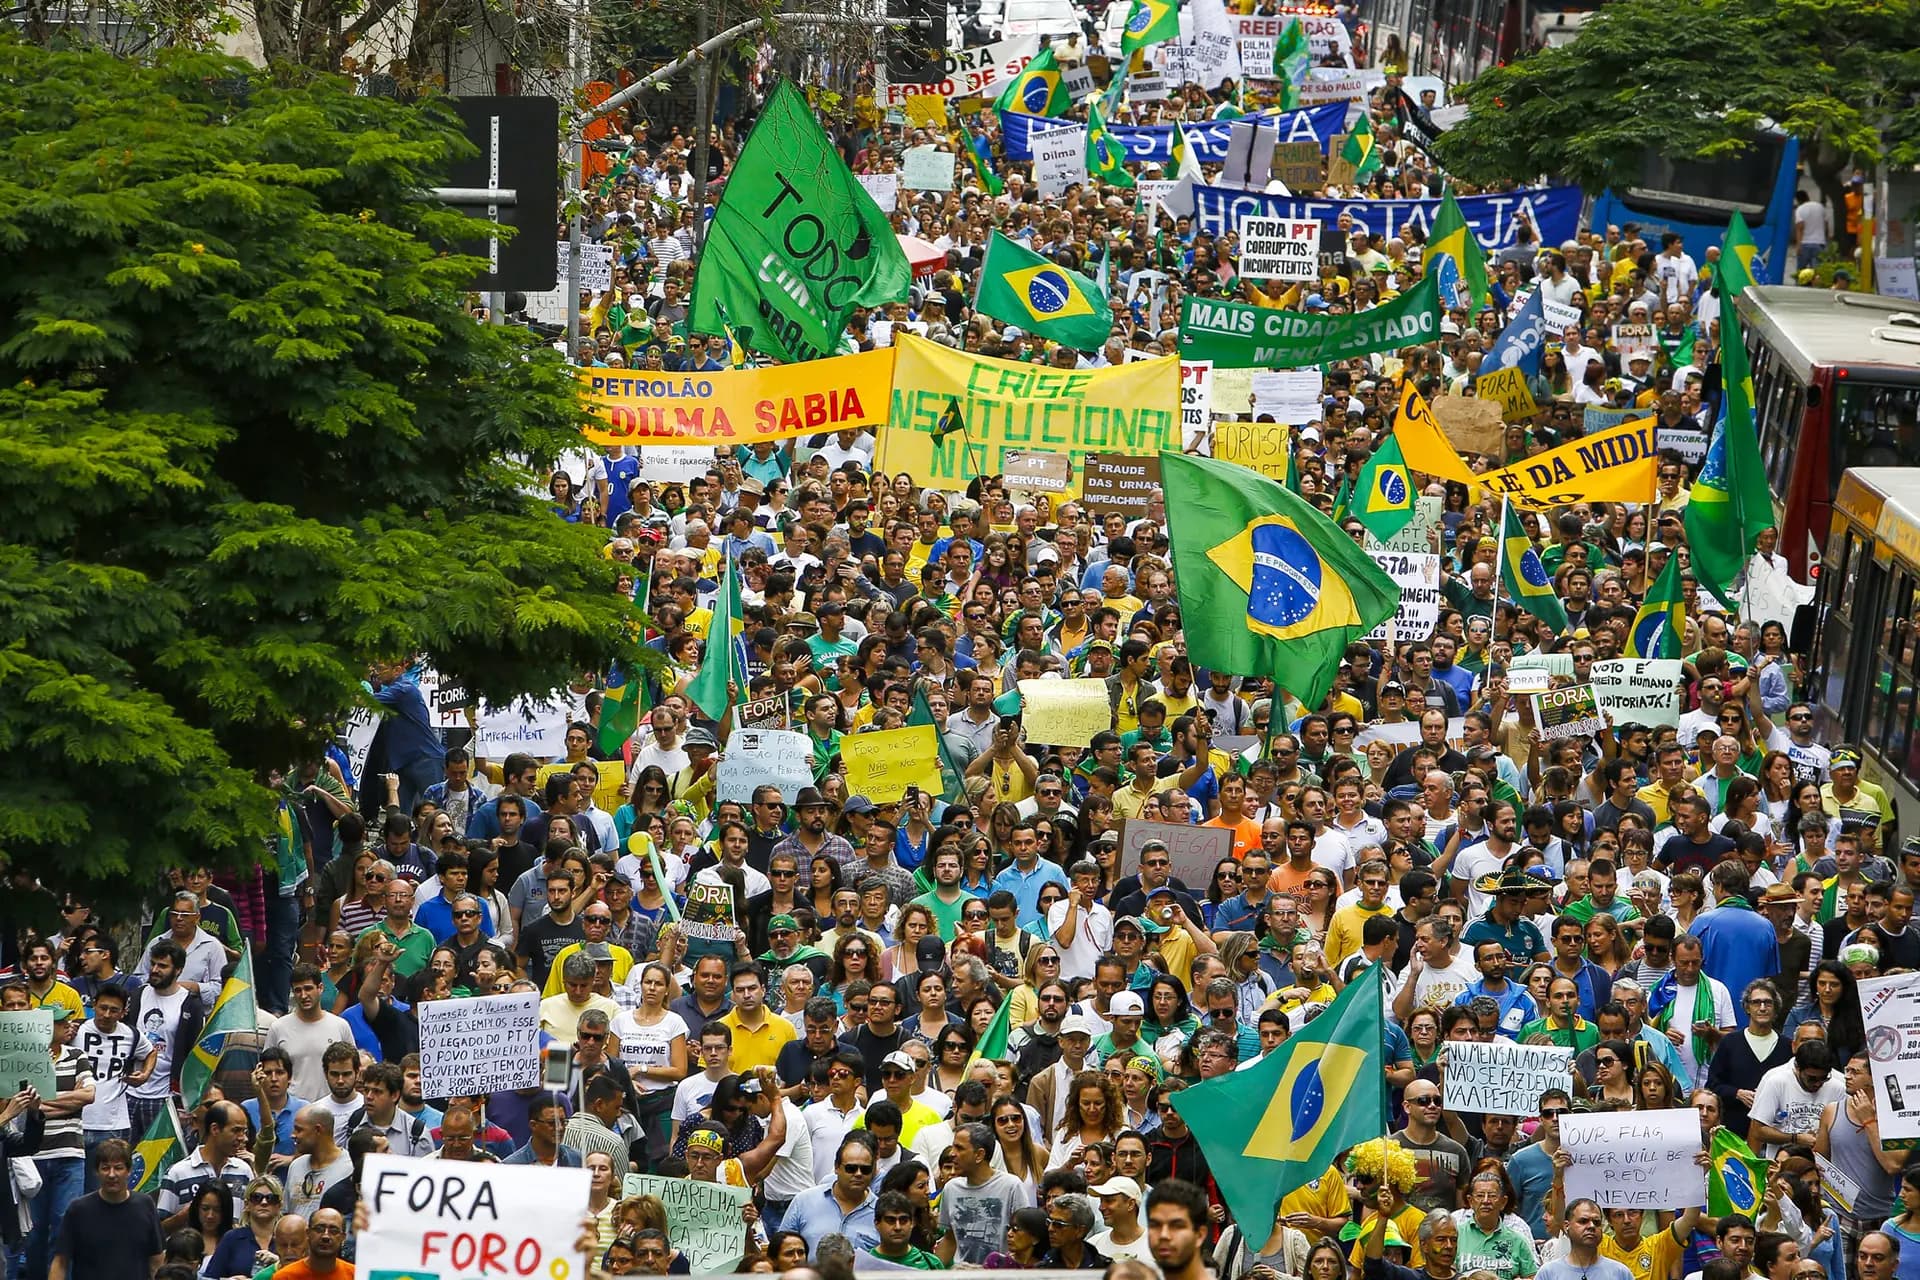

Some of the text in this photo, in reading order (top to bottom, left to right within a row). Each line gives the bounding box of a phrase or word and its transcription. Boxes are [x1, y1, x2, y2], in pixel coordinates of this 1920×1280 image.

[1166, 47, 1197, 57] FRAUDE
[1243, 40, 1270, 49] DILMA
[944, 48, 995, 74] ORA
[1243, 50, 1270, 60] SABIA
[967, 68, 996, 92] DE
[1080, 76, 1090, 90] PT
[1302, 84, 1313, 93] DE
[1336, 80, 1361, 92] PAULO
[1042, 149, 1076, 161] Dilma
[877, 175, 891, 183] US
[1246, 221, 1317, 241] FORA PT
[762, 170, 863, 312] TODO
[1246, 240, 1308, 256] CORRUPTOS
[1243, 258, 1313, 276] INCOMPETENTES
[1189, 303, 1256, 333] MAIS
[1619, 325, 1650, 337] FORA
[592, 377, 713, 398] PETROLÃO
[967, 362, 1095, 400] CRISE
[1479, 371, 1519, 398] FORA
[609, 387, 866, 438] DILMA SABIA
[1215, 425, 1288, 461] FORO SP
[1659, 434, 1708, 443] PETROBRA
[1027, 458, 1047, 469] PT
[1099, 464, 1146, 475] FRAUDE
[1262, 464, 1281, 475] PT
[1527, 457, 1574, 488] DA
[1005, 475, 1066, 488] PERVERSO
[1088, 479, 1160, 490] DAS URNAS
[1084, 493, 1148, 506] IMPEACHME
[1402, 528, 1420, 539] PT
[1365, 541, 1430, 553] AGRADEC
[1265, 556, 1317, 593] E PROGRESSO
[1396, 629, 1425, 640] PAÍS
[1592, 660, 1652, 675] VOTO É
[1508, 676, 1534, 686] FORA
[1542, 688, 1592, 710] FORA
[743, 698, 785, 720] FORA
[441, 709, 462, 726] PT
[777, 749, 804, 761] PAUL
[853, 740, 880, 760] FORO
[903, 735, 920, 749] SP
[720, 767, 739, 778] UMA
[868, 758, 917, 773] NÃO NOS
[721, 781, 748, 795] PARA
[1131, 828, 1219, 855] CHEGA
[691, 885, 729, 904] FORA
[473, 1002, 483, 1015] de
[523, 1001, 531, 1009] e
[1864, 988, 1890, 1013] DILMA
[2, 1023, 52, 1035] EREMOS
[421, 1016, 535, 1038] MAUS EXEMPLOS ESSE
[421, 1036, 428, 1050] É
[428, 1038, 436, 1049] O
[440, 1037, 484, 1048] LEGADO
[486, 1034, 500, 1045] DO
[508, 1030, 522, 1042] PT
[422, 1053, 431, 1065] O
[437, 1050, 468, 1063] POVO
[621, 1045, 666, 1055] VERYONE
[422, 1057, 538, 1080] GOVERNTES TEM QUE
[1446, 1062, 1476, 1083] NÃO
[1479, 1067, 1498, 1086] SE
[1501, 1068, 1525, 1091] FAZ
[423, 1079, 444, 1091] DAR
[450, 1076, 475, 1088] BONS
[480, 1071, 524, 1086] EXEMPLOS
[447, 1085, 489, 1097] SEGUIDO
[489, 1083, 508, 1093] PELO
[511, 1080, 533, 1090] POVO
[1619, 1126, 1664, 1140] FLAG
[1569, 1151, 1620, 1166] NEVER
[1666, 1150, 1685, 1162] BE
[1826, 1166, 1846, 1188] FORA
[375, 1171, 499, 1221] FORA
[668, 1206, 744, 1232] UERO UMA
[696, 1227, 740, 1257] JUSTA
[420, 1231, 542, 1277] FORO
